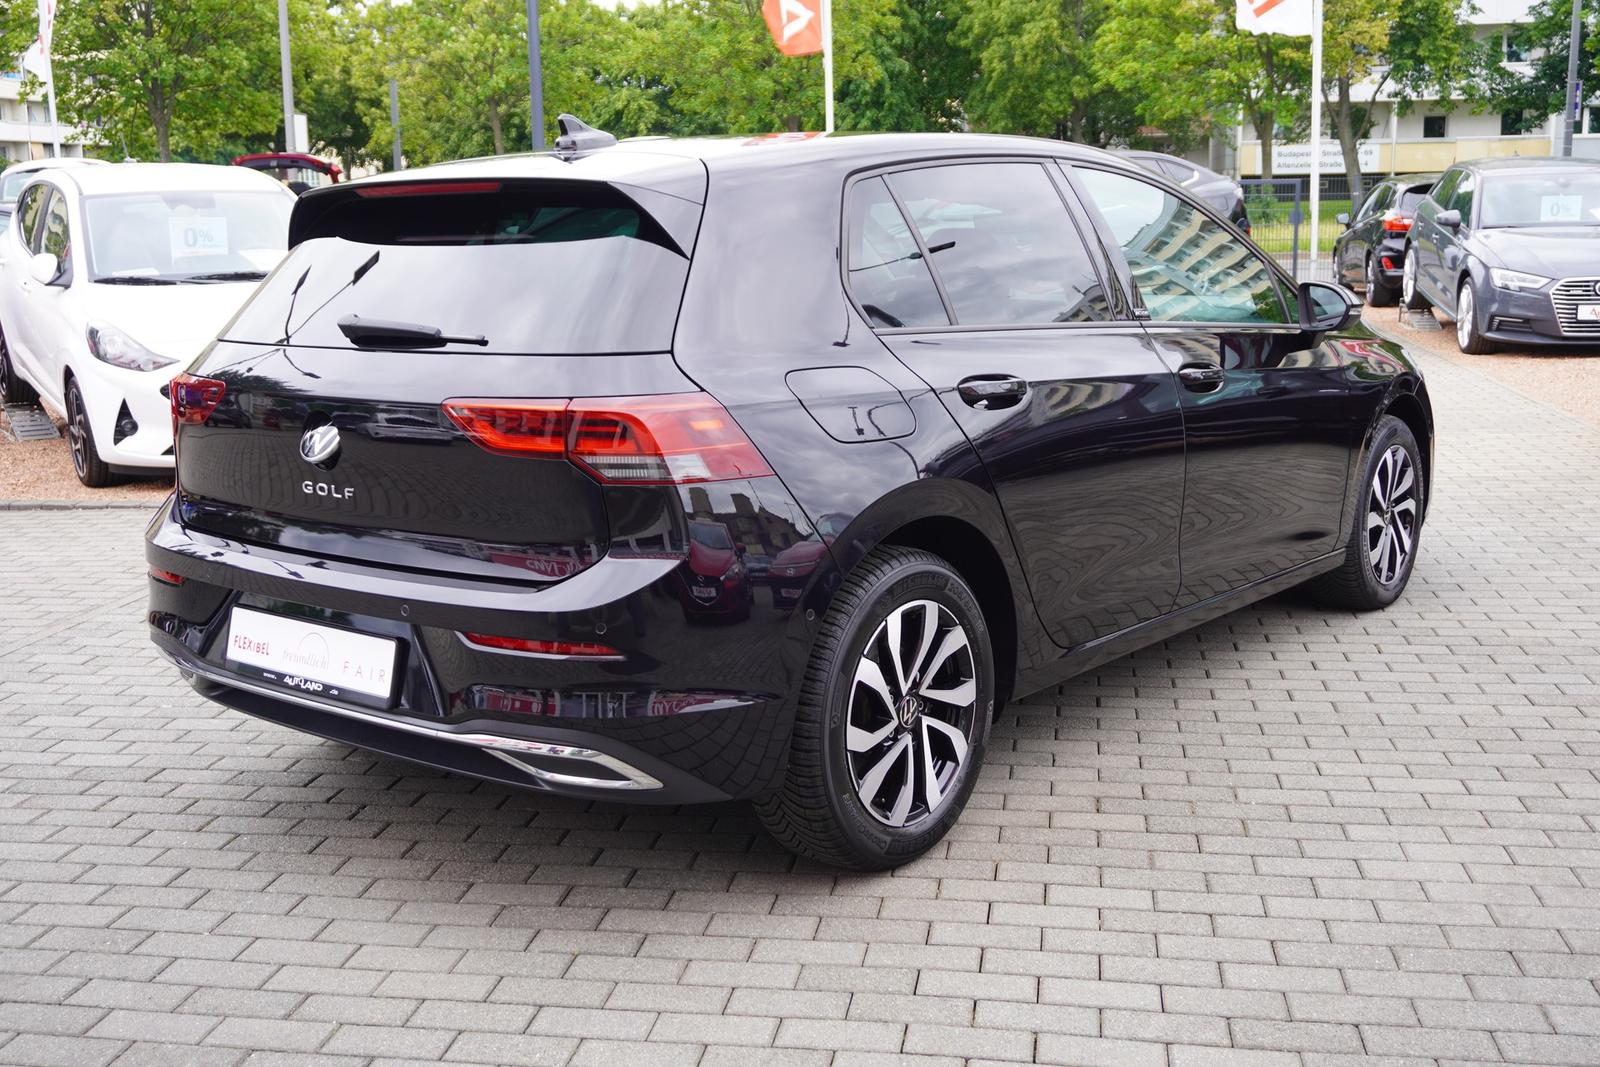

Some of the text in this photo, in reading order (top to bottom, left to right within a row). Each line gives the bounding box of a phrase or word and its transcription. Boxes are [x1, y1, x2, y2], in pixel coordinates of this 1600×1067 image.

[183, 227, 214, 248] 0%
[302, 480, 355, 500] GOLF
[233, 635, 270, 656] FLEXIBEL
[283, 675, 323, 692] AUTOLAND
